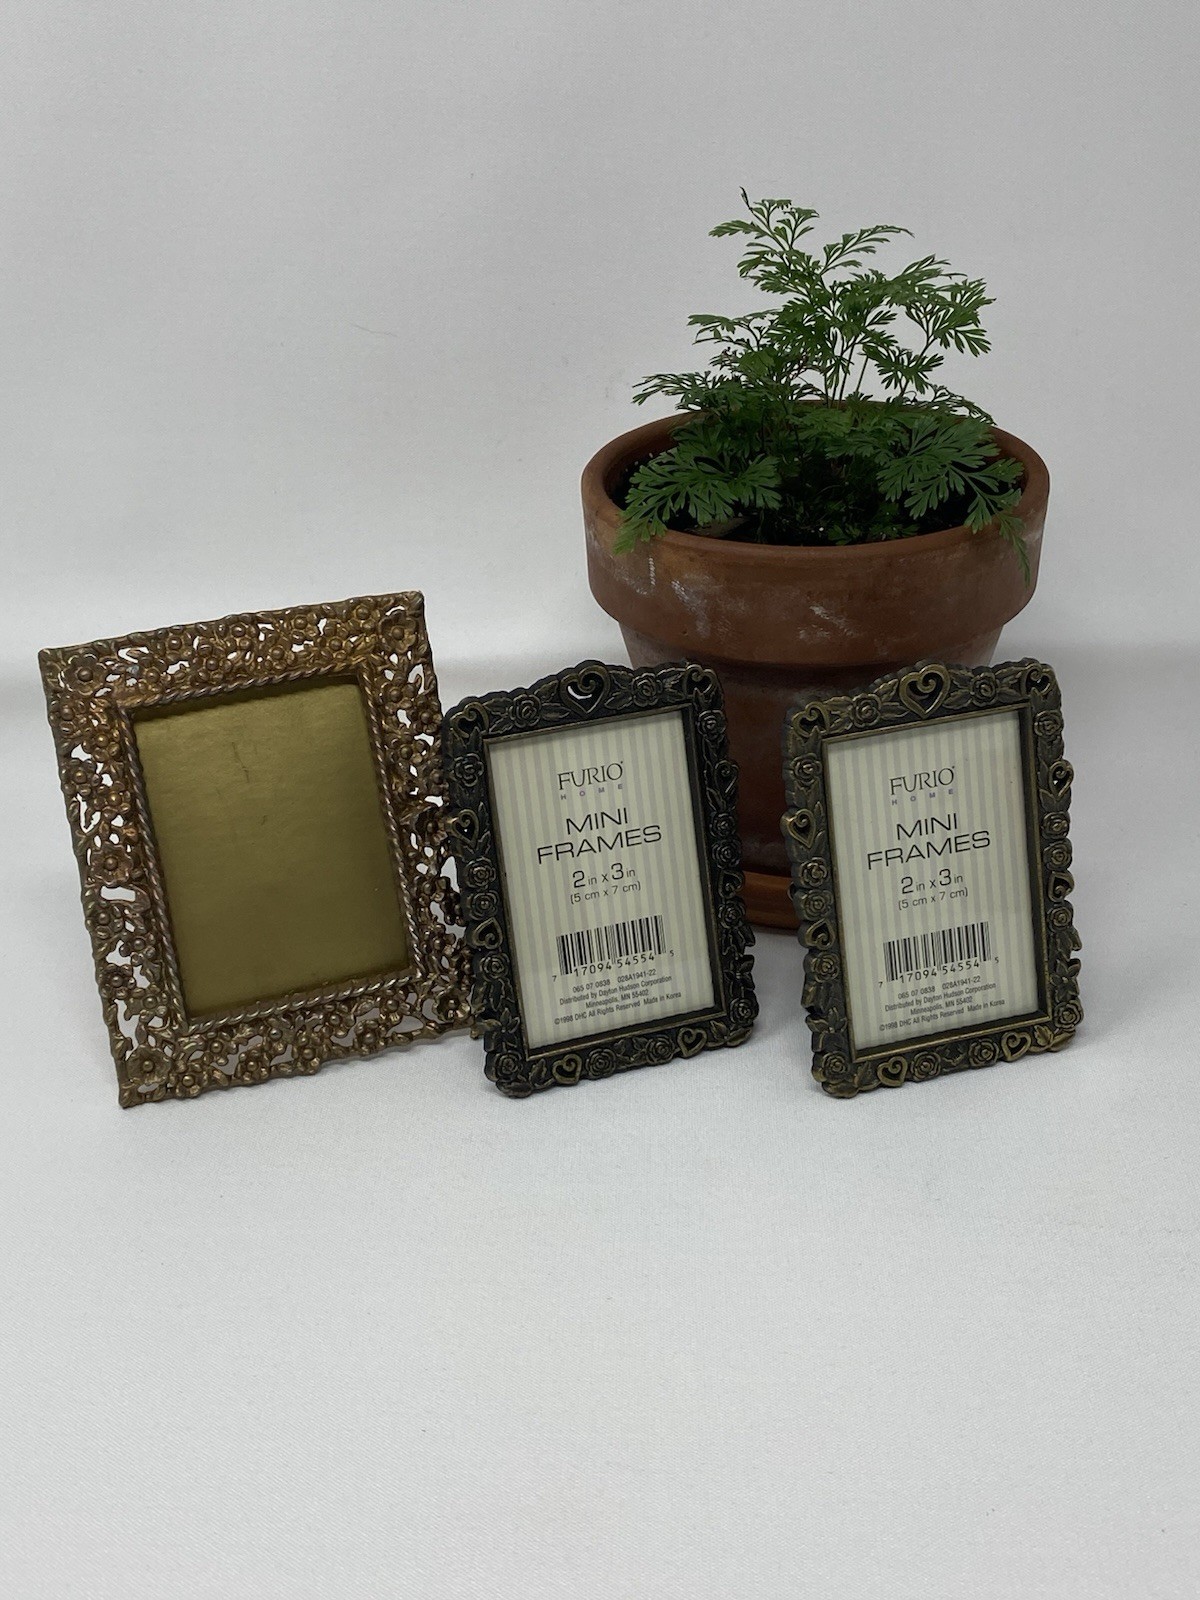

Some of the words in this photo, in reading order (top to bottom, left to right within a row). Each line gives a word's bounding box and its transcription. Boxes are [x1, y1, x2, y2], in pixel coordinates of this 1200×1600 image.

[558, 762, 623, 790] FURIO
[890, 767, 954, 795] FURIO
[566, 807, 628, 835] MINI
[897, 813, 958, 840] MINI
[537, 825, 662, 864] FRAMES
[867, 830, 990, 870] FRAMES
[572, 870, 585, 888] 2
[588, 876, 597, 885] in
[601, 874, 609, 882] x
[611, 863, 624, 880] 3
[626, 868, 635, 877] in
[901, 876, 913, 894] 2
[916, 882, 925, 891] in
[930, 880, 936, 888] x
[939, 868, 951, 886] 3
[954, 874, 963, 884] in
[570, 893, 581, 904] (5
[584, 890, 600, 900] cm
[612, 886, 618, 894] 7
[622, 881, 641, 892] cm)
[898, 900, 909, 910] (5
[912, 896, 927, 906] cm
[930, 895, 936, 903] x
[940, 892, 946, 900] 7
[950, 887, 968, 898] cm)
[574, 962, 611, 976] 17094
[617, 954, 654, 968] 54554
[900, 969, 937, 983] 17094
[943, 961, 979, 975] 54554
[560, 994, 589, 1005] Distributed
[599, 987, 617, 996] Dayton
[619, 983, 639, 991] Hudson
[641, 976, 672, 987] Corporation
[944, 991, 963, 999] Hudson
[965, 983, 996, 993] Corporation
[597, 1006, 614, 1015] Rights
[616, 1001, 640, 1011] Reserved
[644, 997, 658, 1005] Made
[666, 992, 681, 1000] Korea
[921, 1014, 939, 1022] Rights
[940, 1009, 964, 1018] Reserved
[967, 1004, 982, 1012] Made
